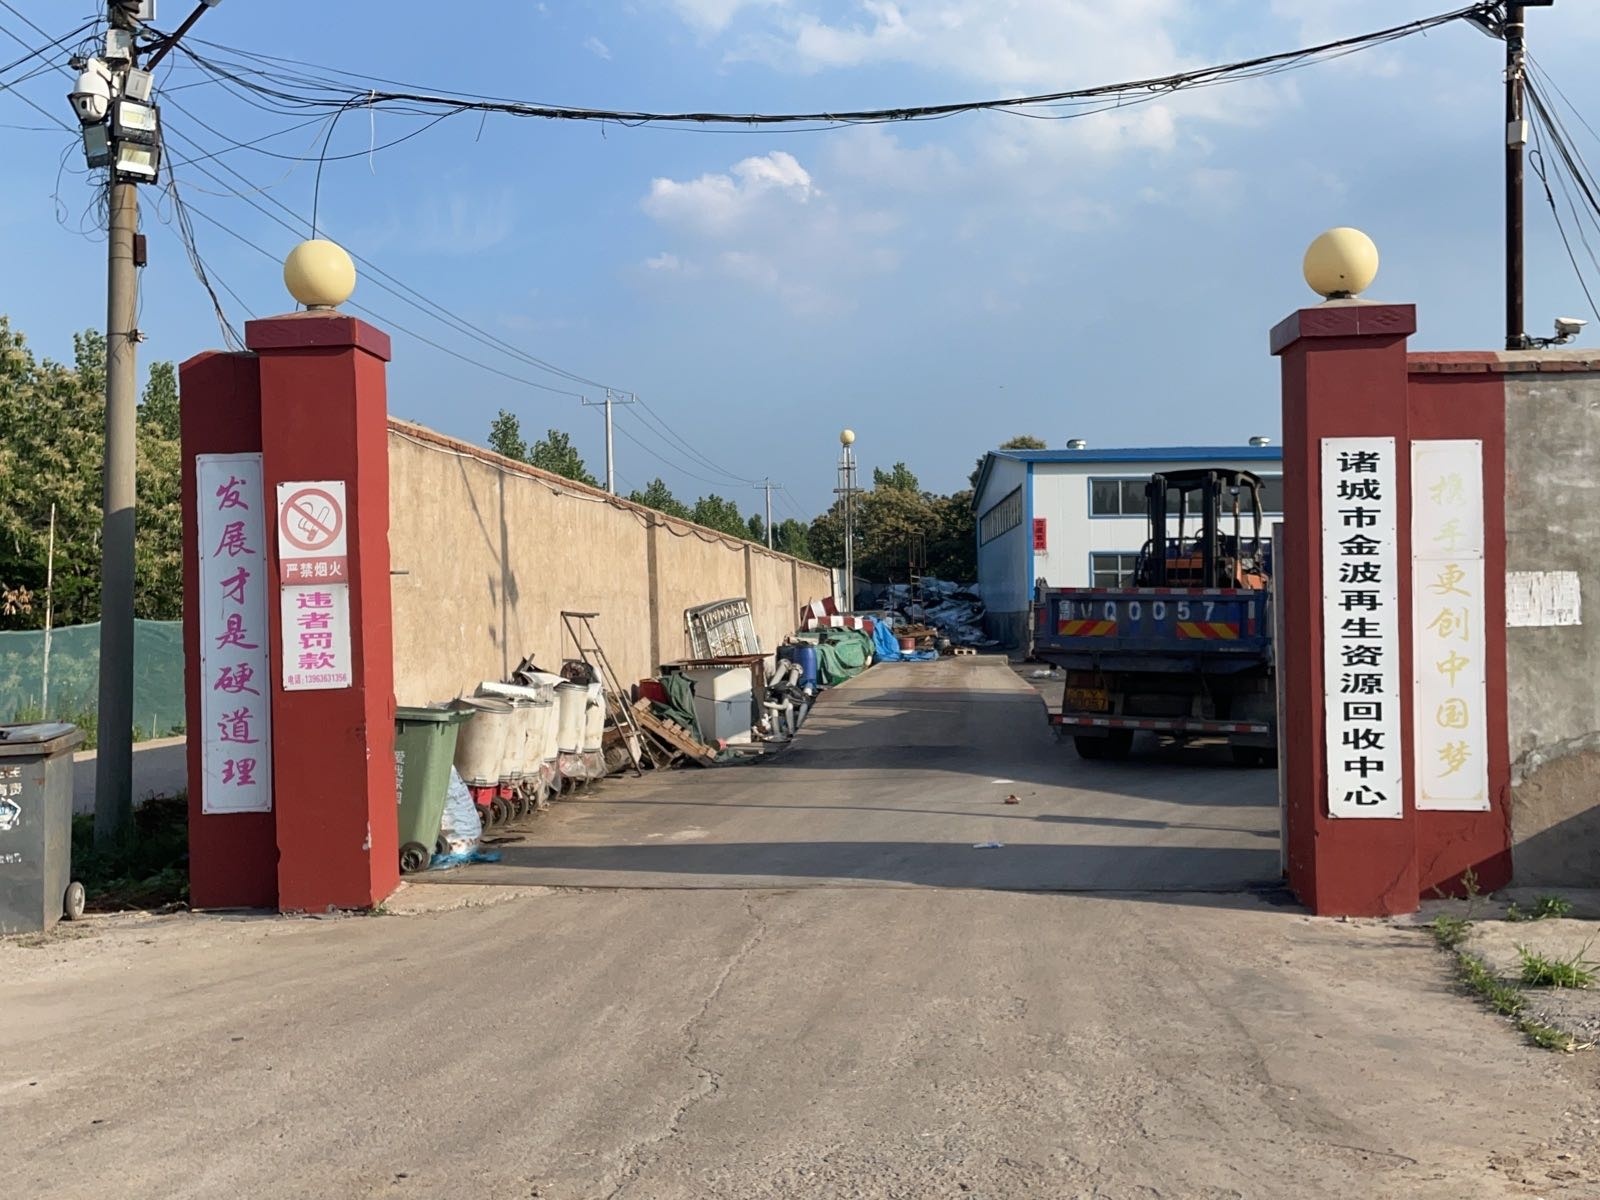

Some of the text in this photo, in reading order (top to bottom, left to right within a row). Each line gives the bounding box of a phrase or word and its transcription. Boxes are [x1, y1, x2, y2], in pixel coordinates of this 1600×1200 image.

[213, 476, 261, 787] 发展才是硬道理
[286, 561, 342, 578] 严禁烟火
[296, 591, 336, 670] 违者罚款
[1337, 450, 1387, 807] 诸城市金波再生资源回收中心
